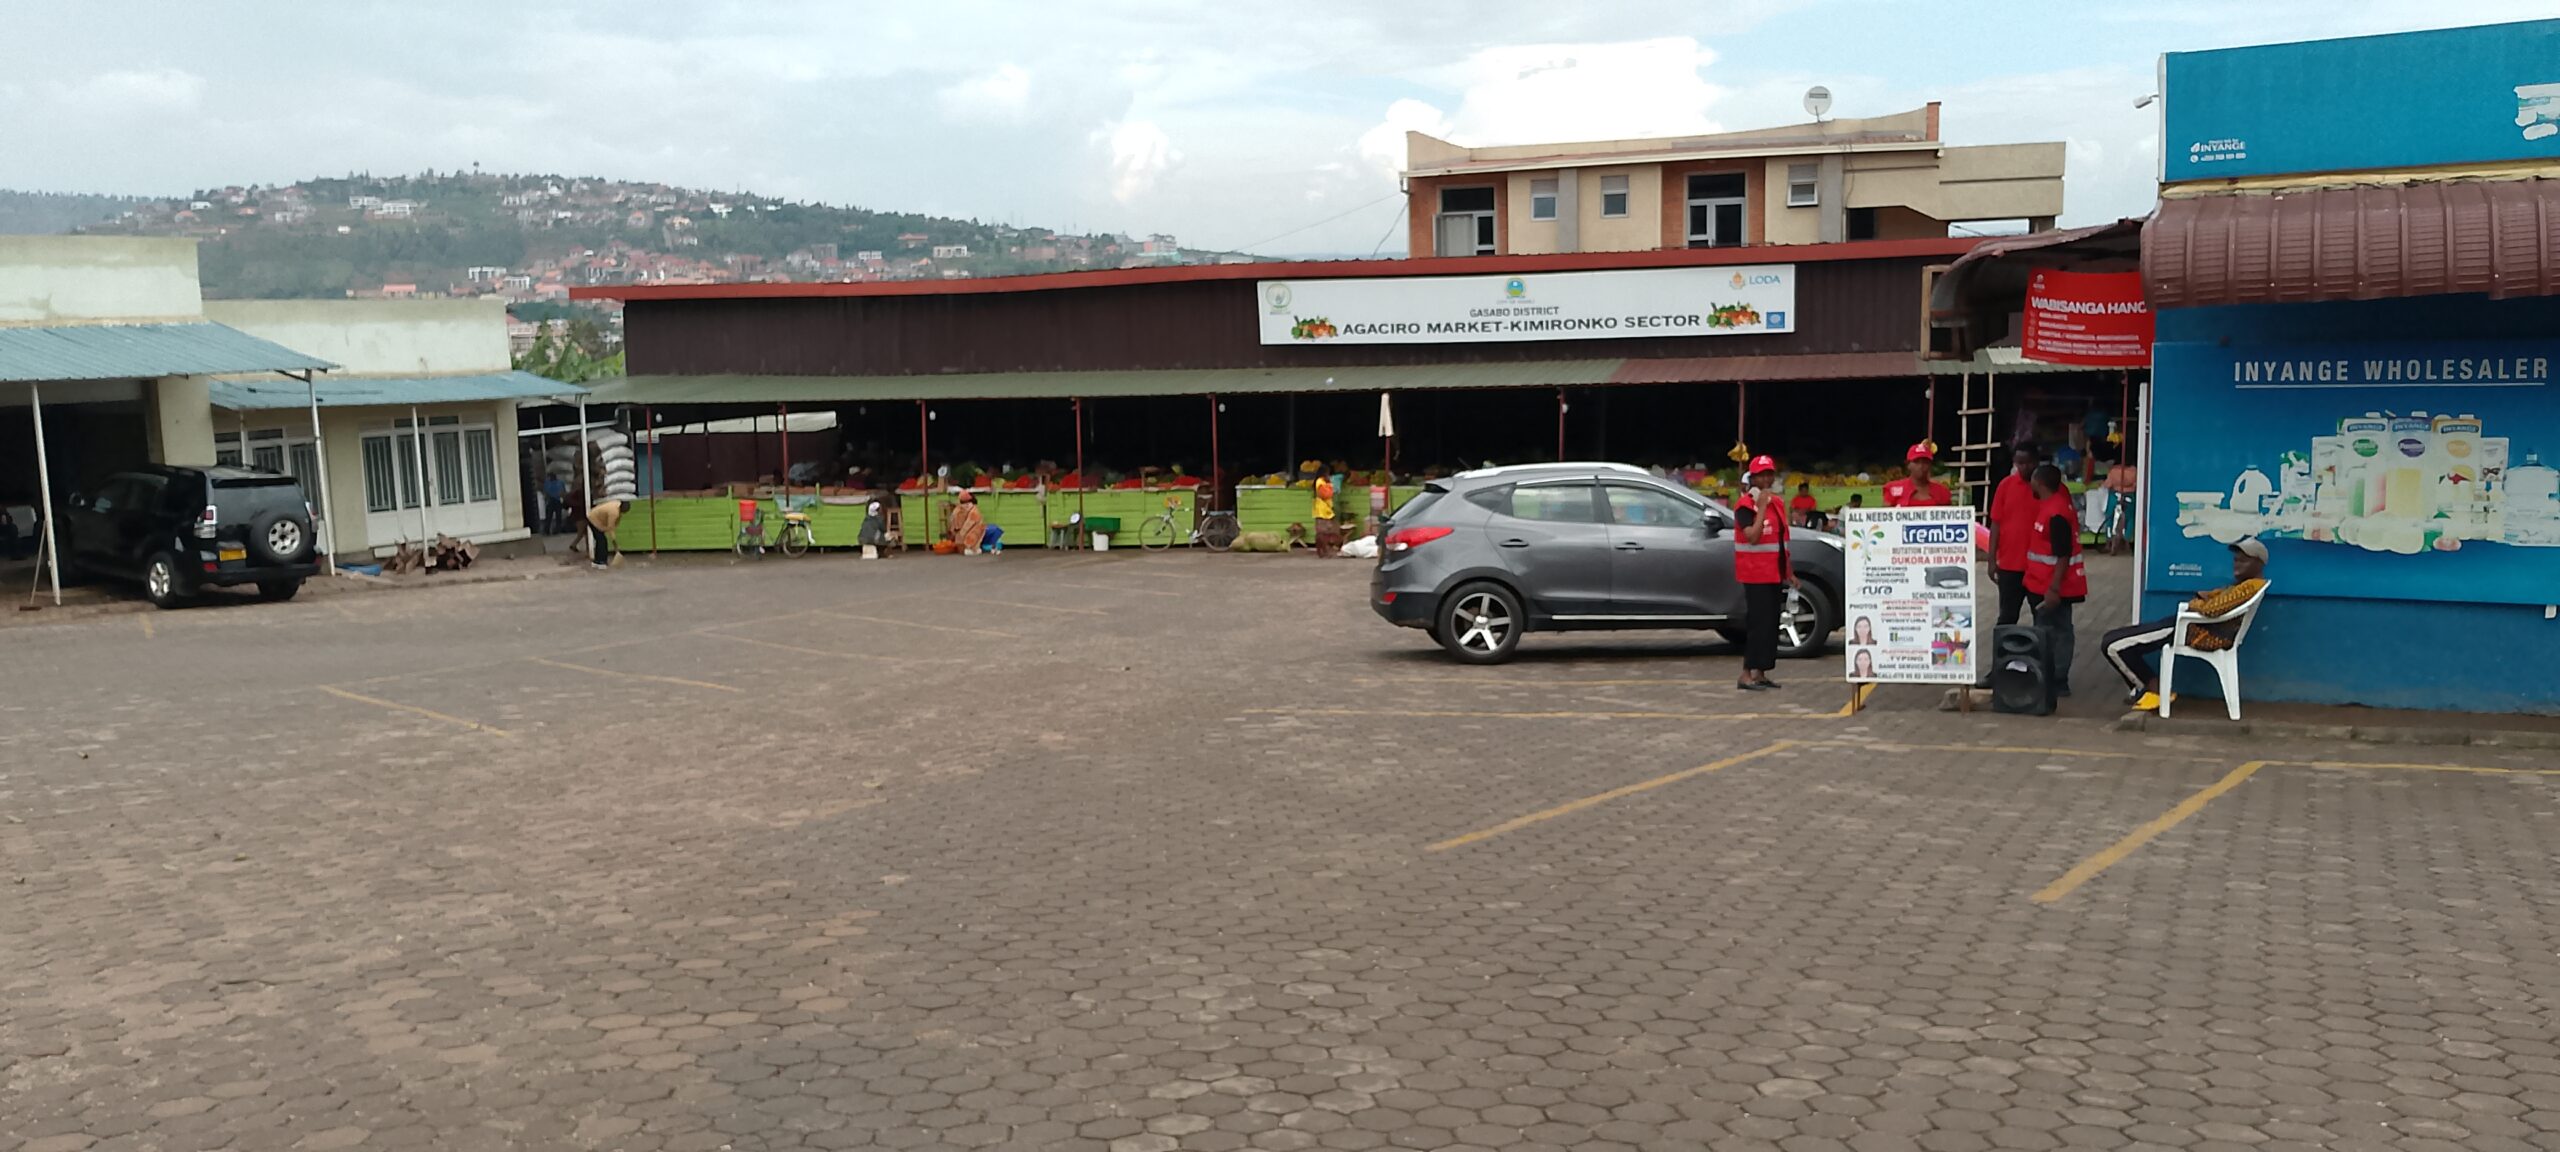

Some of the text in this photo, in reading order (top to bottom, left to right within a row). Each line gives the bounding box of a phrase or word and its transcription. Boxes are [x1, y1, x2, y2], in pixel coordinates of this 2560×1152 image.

[2200, 141, 2246, 152] INYANGE
[1749, 274, 1781, 285] LODA
[2031, 296, 2106, 315] WABISANGA
[1469, 306, 1560, 318] GASABO DISTRICT
[1343, 314, 1701, 335] AGACIRO MARKET-KIMIRONKO SECTOR
[2234, 357, 2548, 382] INYANGE WHOLESALER
[1849, 510, 1972, 522] ALL NEEDS ONLINE SERVICES
[1891, 555, 1968, 565] DUKORA IBYAPA
[1862, 585, 1893, 596] rura
[1912, 592, 1971, 600] SCHOOL MATERIALS
